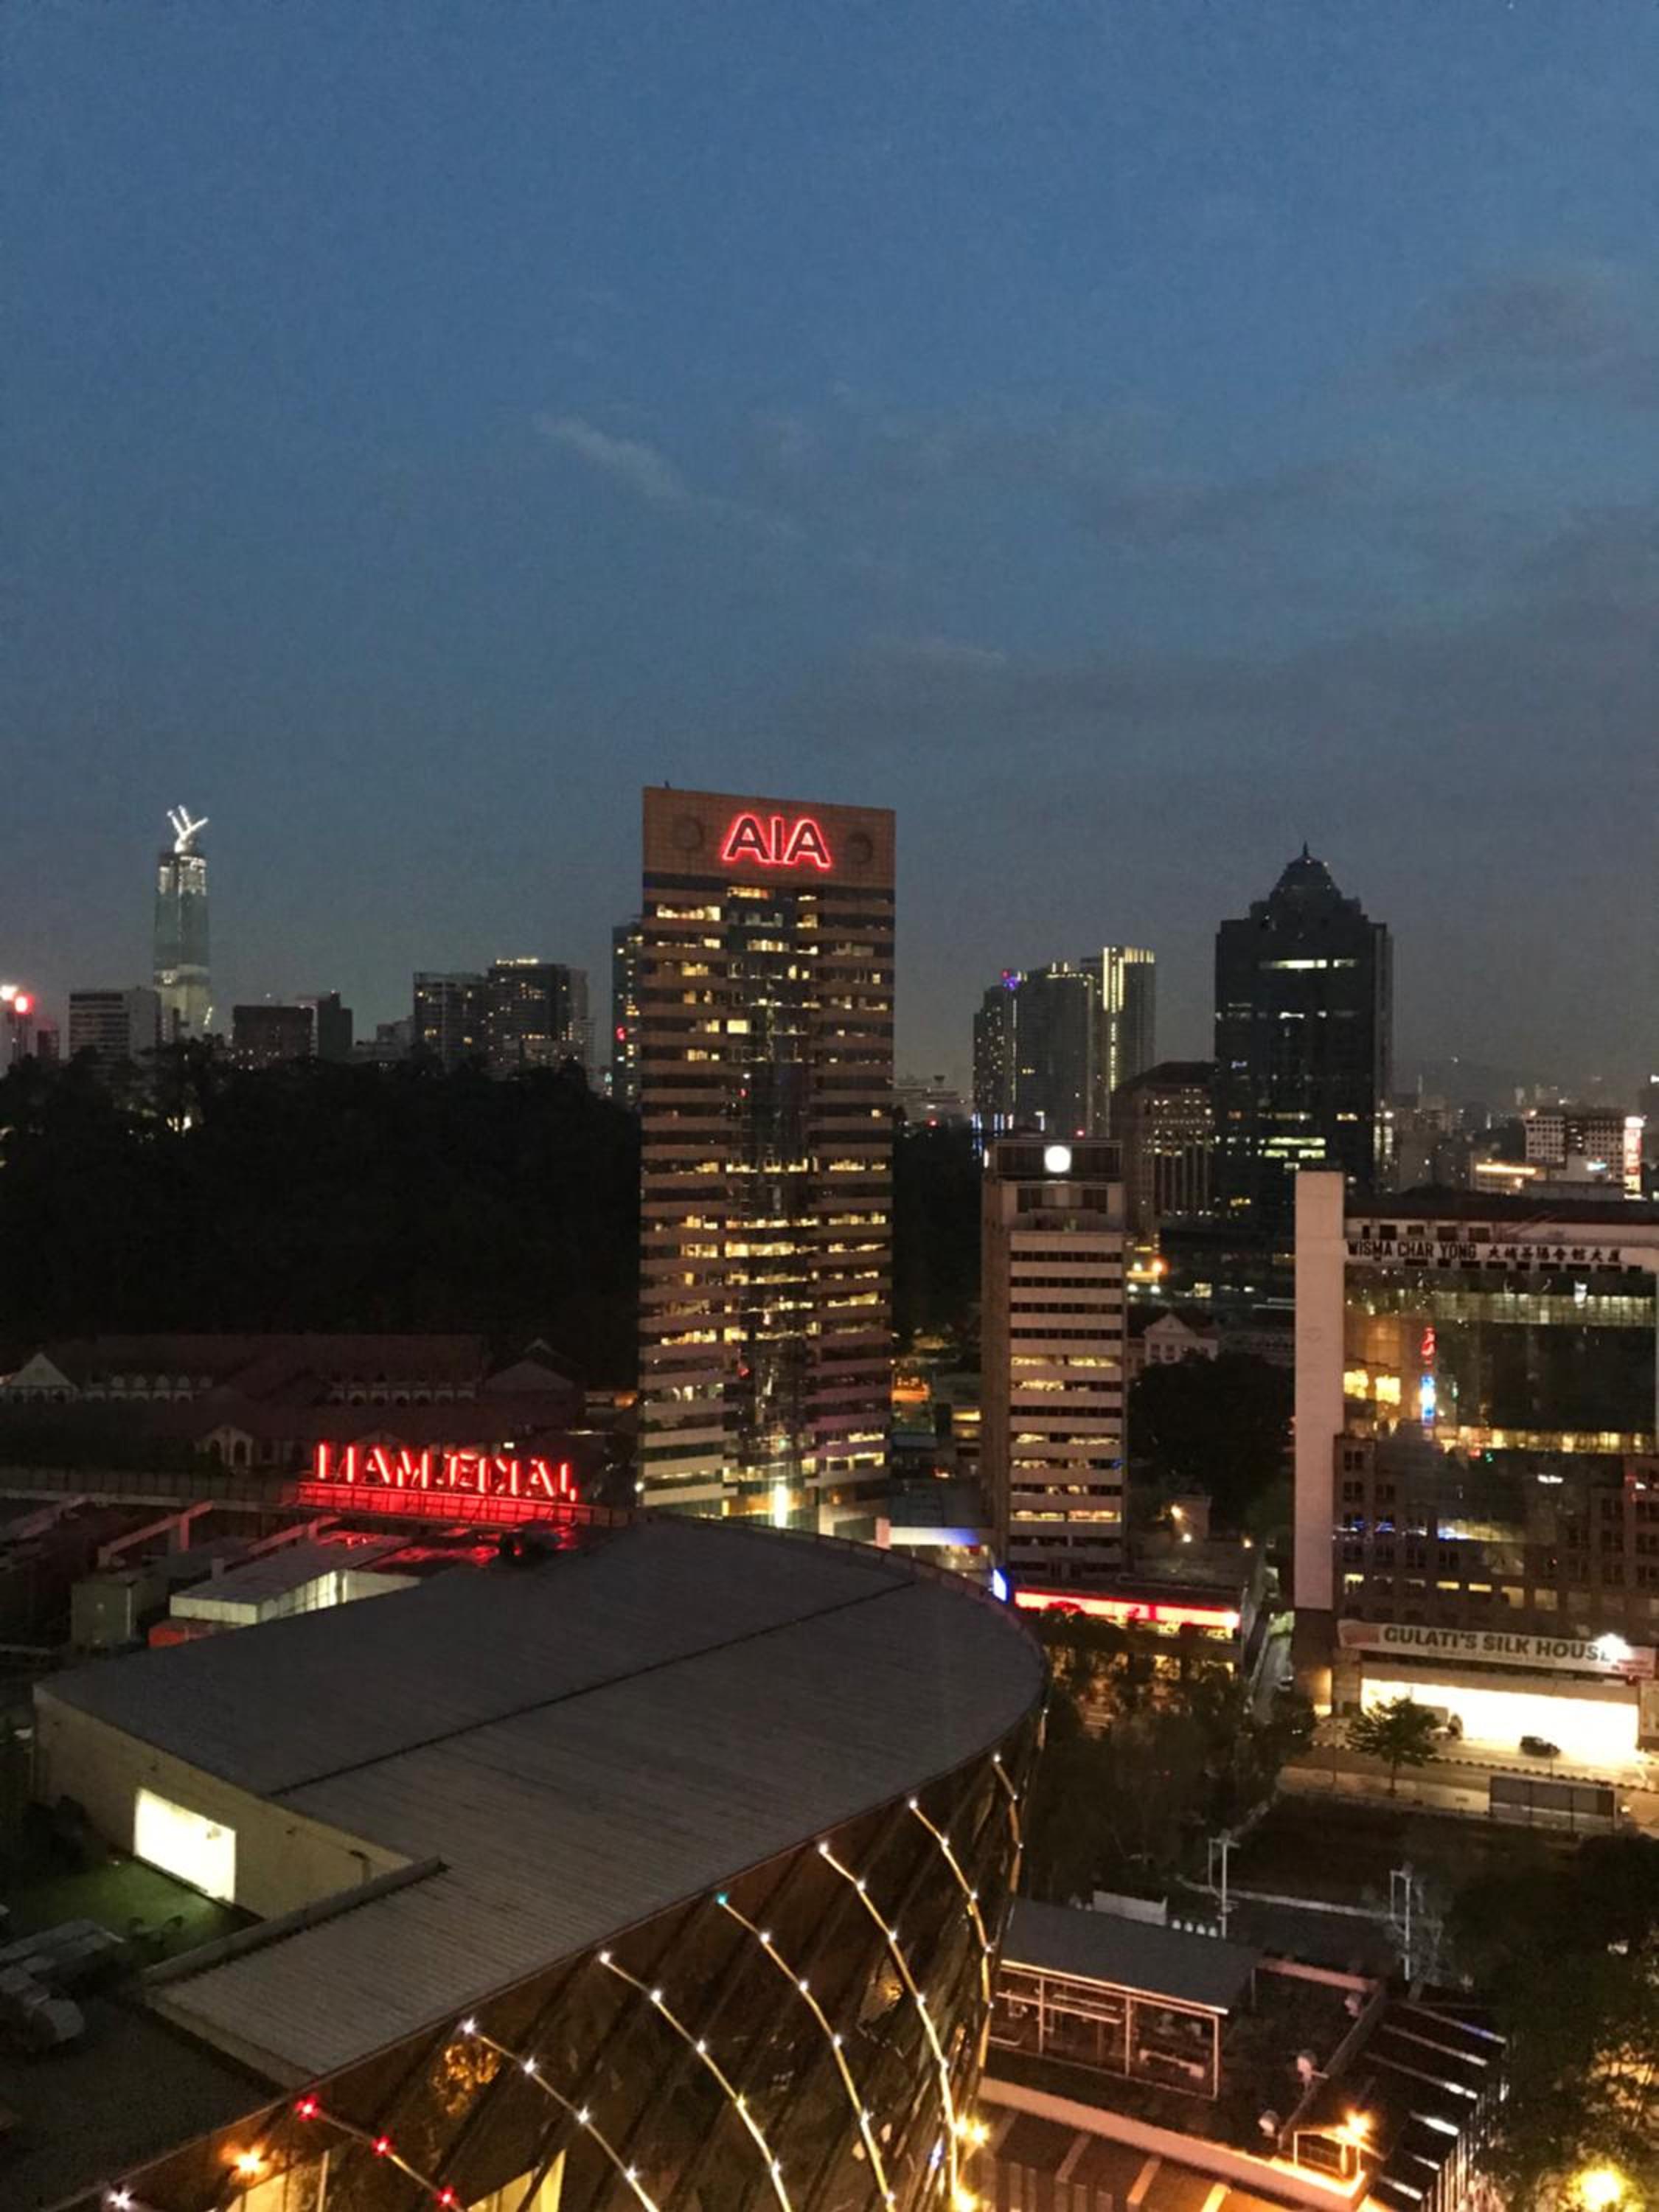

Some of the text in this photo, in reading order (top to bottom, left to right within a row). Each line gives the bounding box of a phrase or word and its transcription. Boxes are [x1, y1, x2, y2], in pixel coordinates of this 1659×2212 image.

[722, 813, 832, 869] AIA
[1347, 1239, 1476, 1259] WISMA CHAR YONG
[1384, 1627, 1477, 1646] GULATI'S
[1483, 1634, 1529, 1651] SILK
